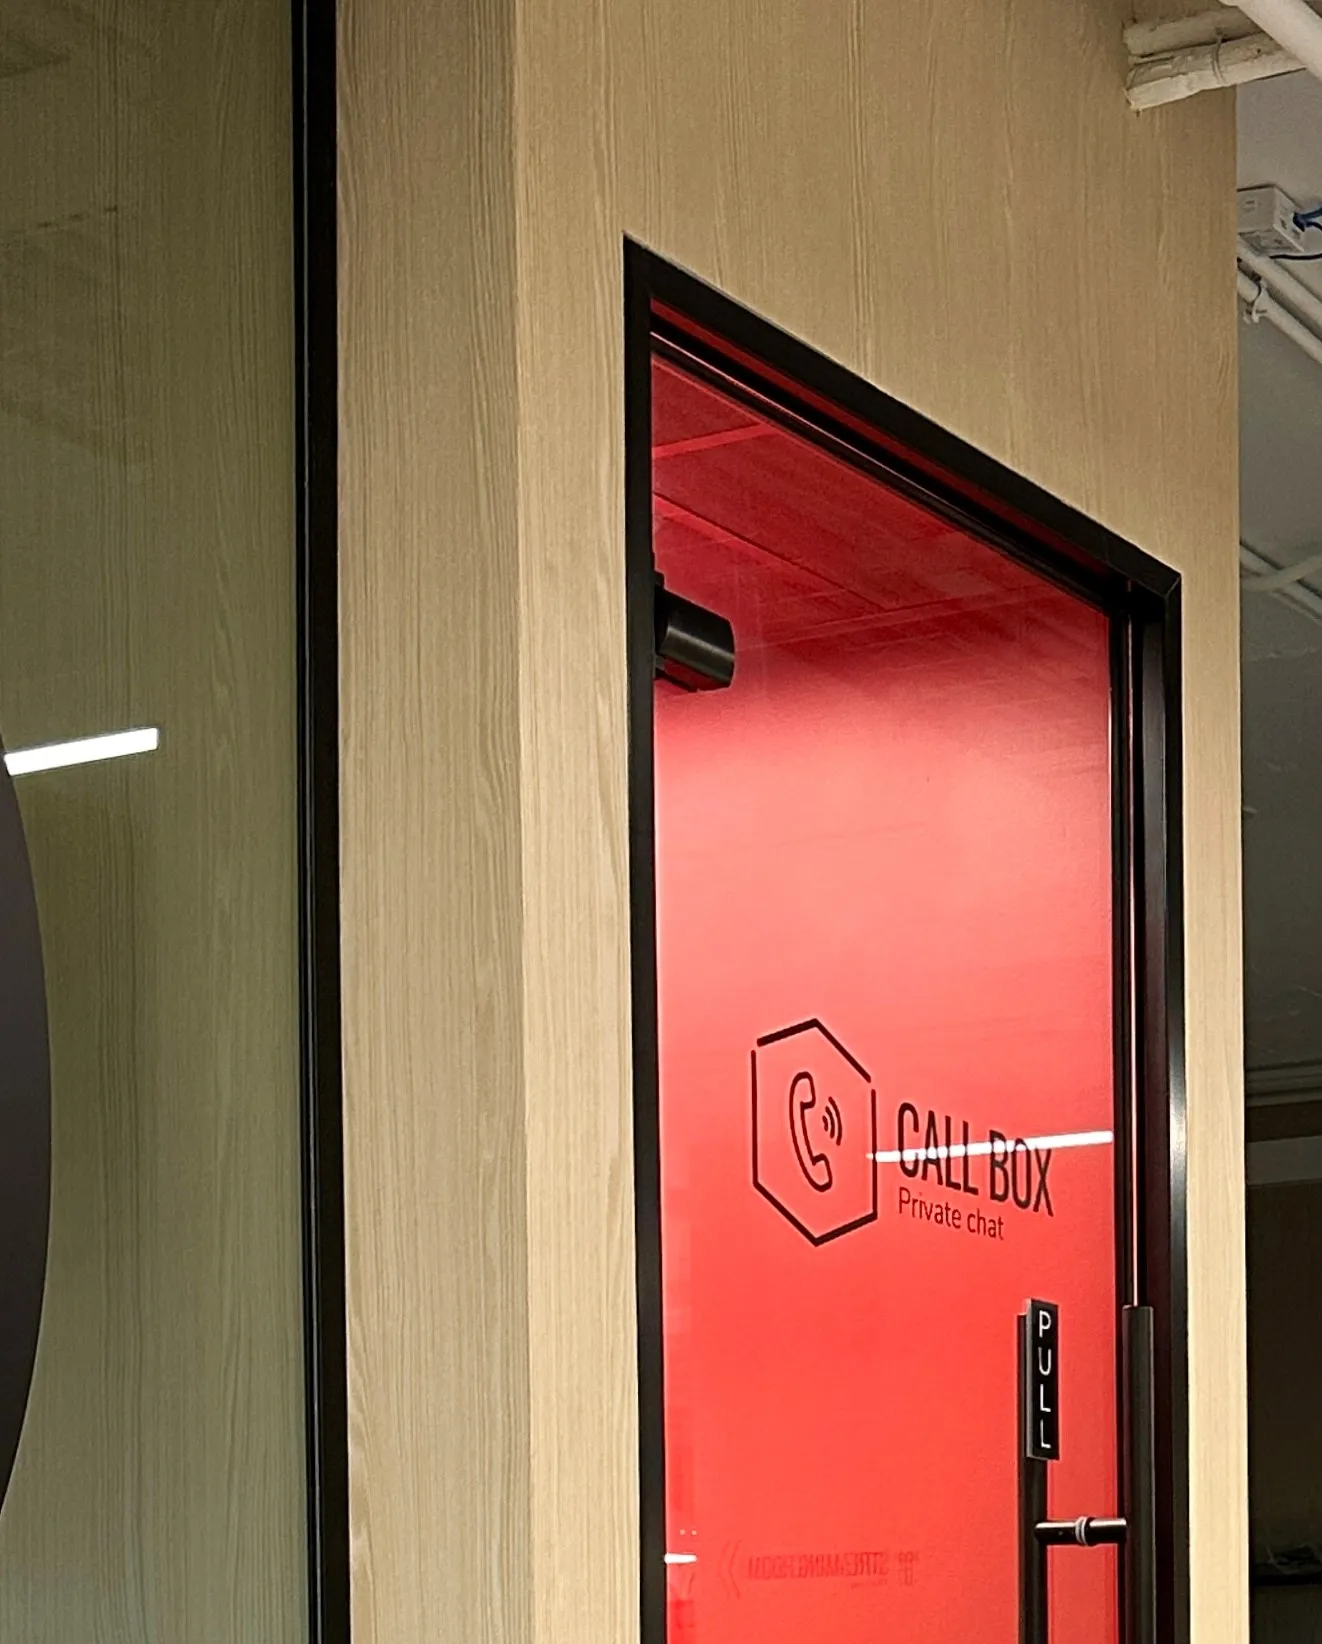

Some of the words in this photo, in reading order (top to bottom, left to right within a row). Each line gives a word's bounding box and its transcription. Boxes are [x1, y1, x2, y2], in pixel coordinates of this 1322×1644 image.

[897, 1102, 979, 1196] CALL
[989, 1129, 1054, 1217] BOX
[898, 1186, 962, 1229] Private
[967, 1208, 1005, 1240] chat
[1038, 1309, 1052, 1448] PULL
